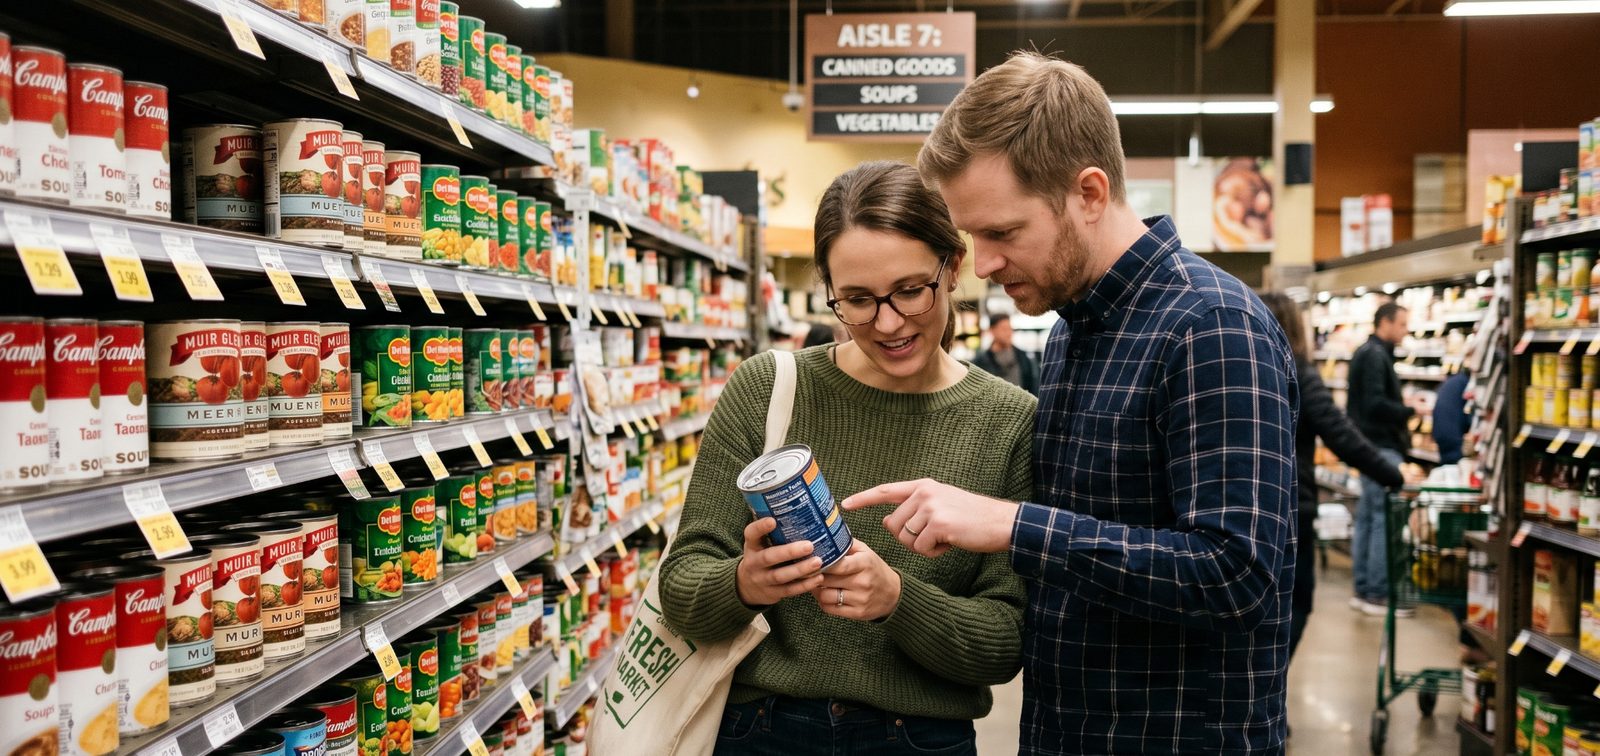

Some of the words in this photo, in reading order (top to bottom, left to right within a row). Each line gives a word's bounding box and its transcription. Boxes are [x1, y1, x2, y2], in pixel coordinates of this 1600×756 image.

[838, 24, 911, 47] AISLE
[917, 24, 942, 47] 7:
[822, 58, 893, 76] CANNED
[895, 57, 956, 75] GOODS
[860, 85, 918, 103] SOUPS
[313, 131, 336, 147] MUIR
[185, 332, 217, 350] MUIR
[271, 333, 299, 349] MUIR
[311, 528, 335, 544] MUIR
[269, 541, 296, 560] MUIR
[223, 556, 251, 574] MUIR
[186, 567, 211, 588] MUIR
